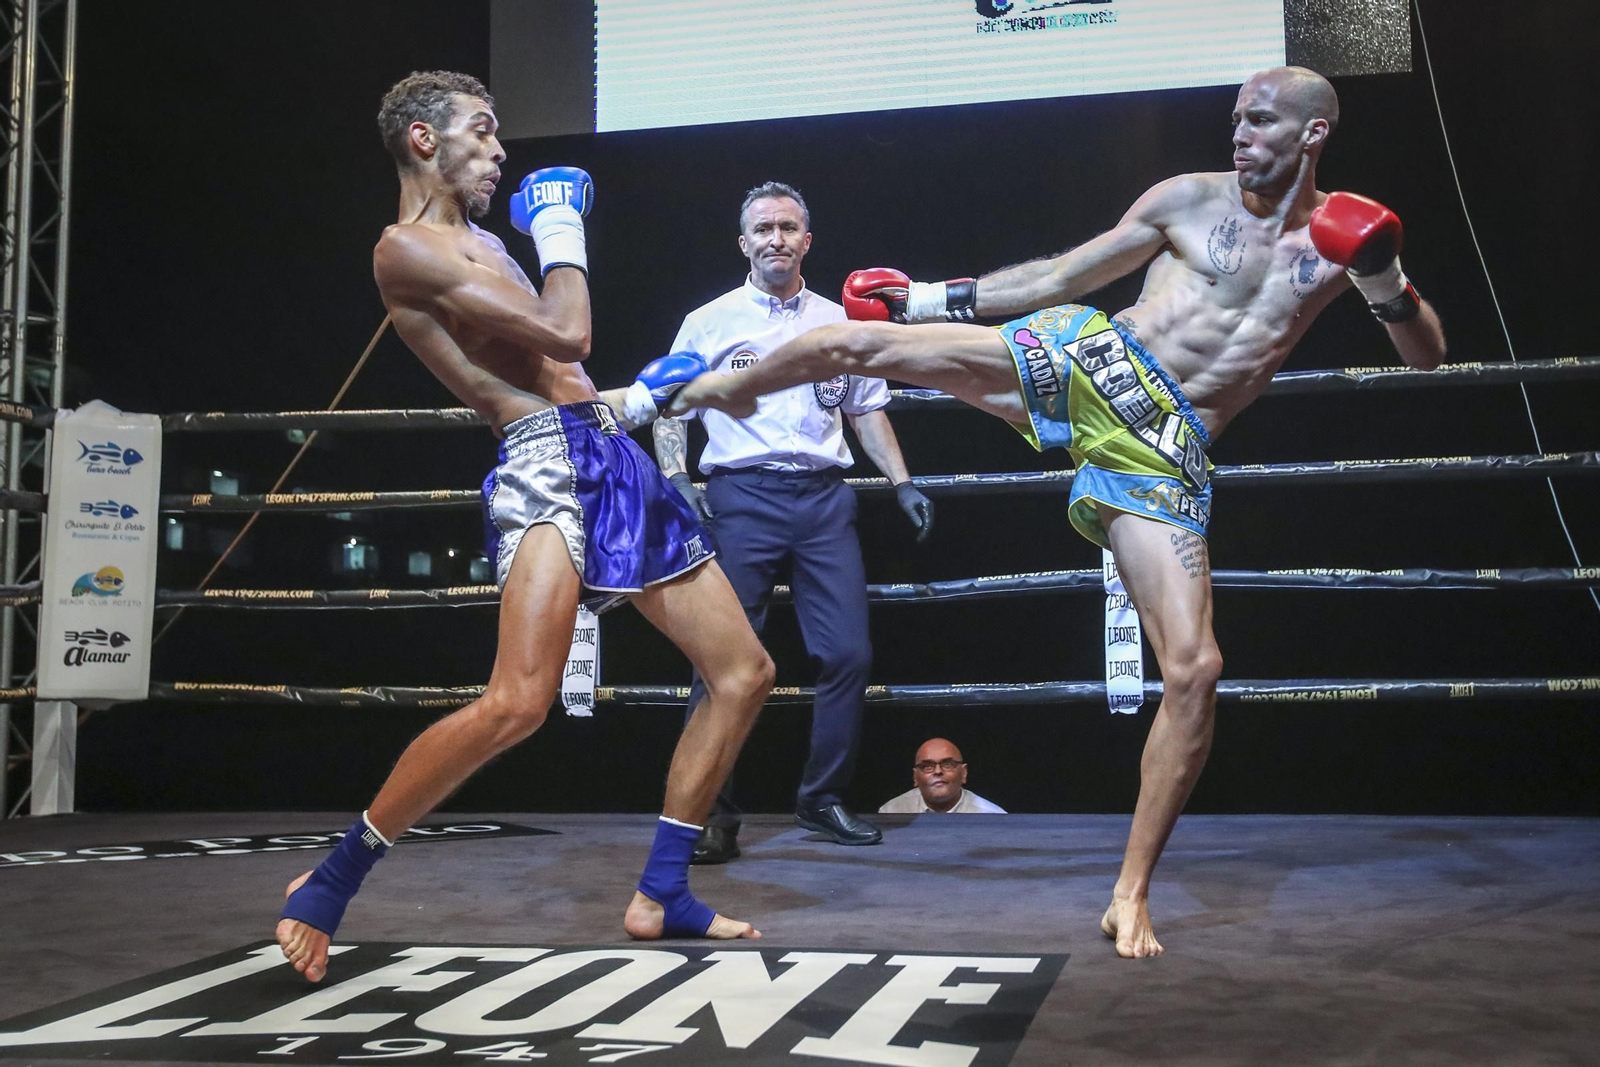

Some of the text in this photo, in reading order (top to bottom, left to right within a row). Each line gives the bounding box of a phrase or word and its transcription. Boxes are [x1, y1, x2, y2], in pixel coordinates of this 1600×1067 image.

[1025, 348, 1058, 396] CADIZ
[822, 386, 840, 397] WBC
[572, 628, 596, 646] EONE
[1108, 626, 1138, 646] LEONE
[565, 660, 594, 678] LEONE
[1109, 660, 1139, 680] LEONE
[564, 692, 592, 708] LEONE
[1110, 694, 1141, 707] LEONE
[0, 944, 1041, 1067] LEONE
[257, 1036, 673, 1063] 1947
